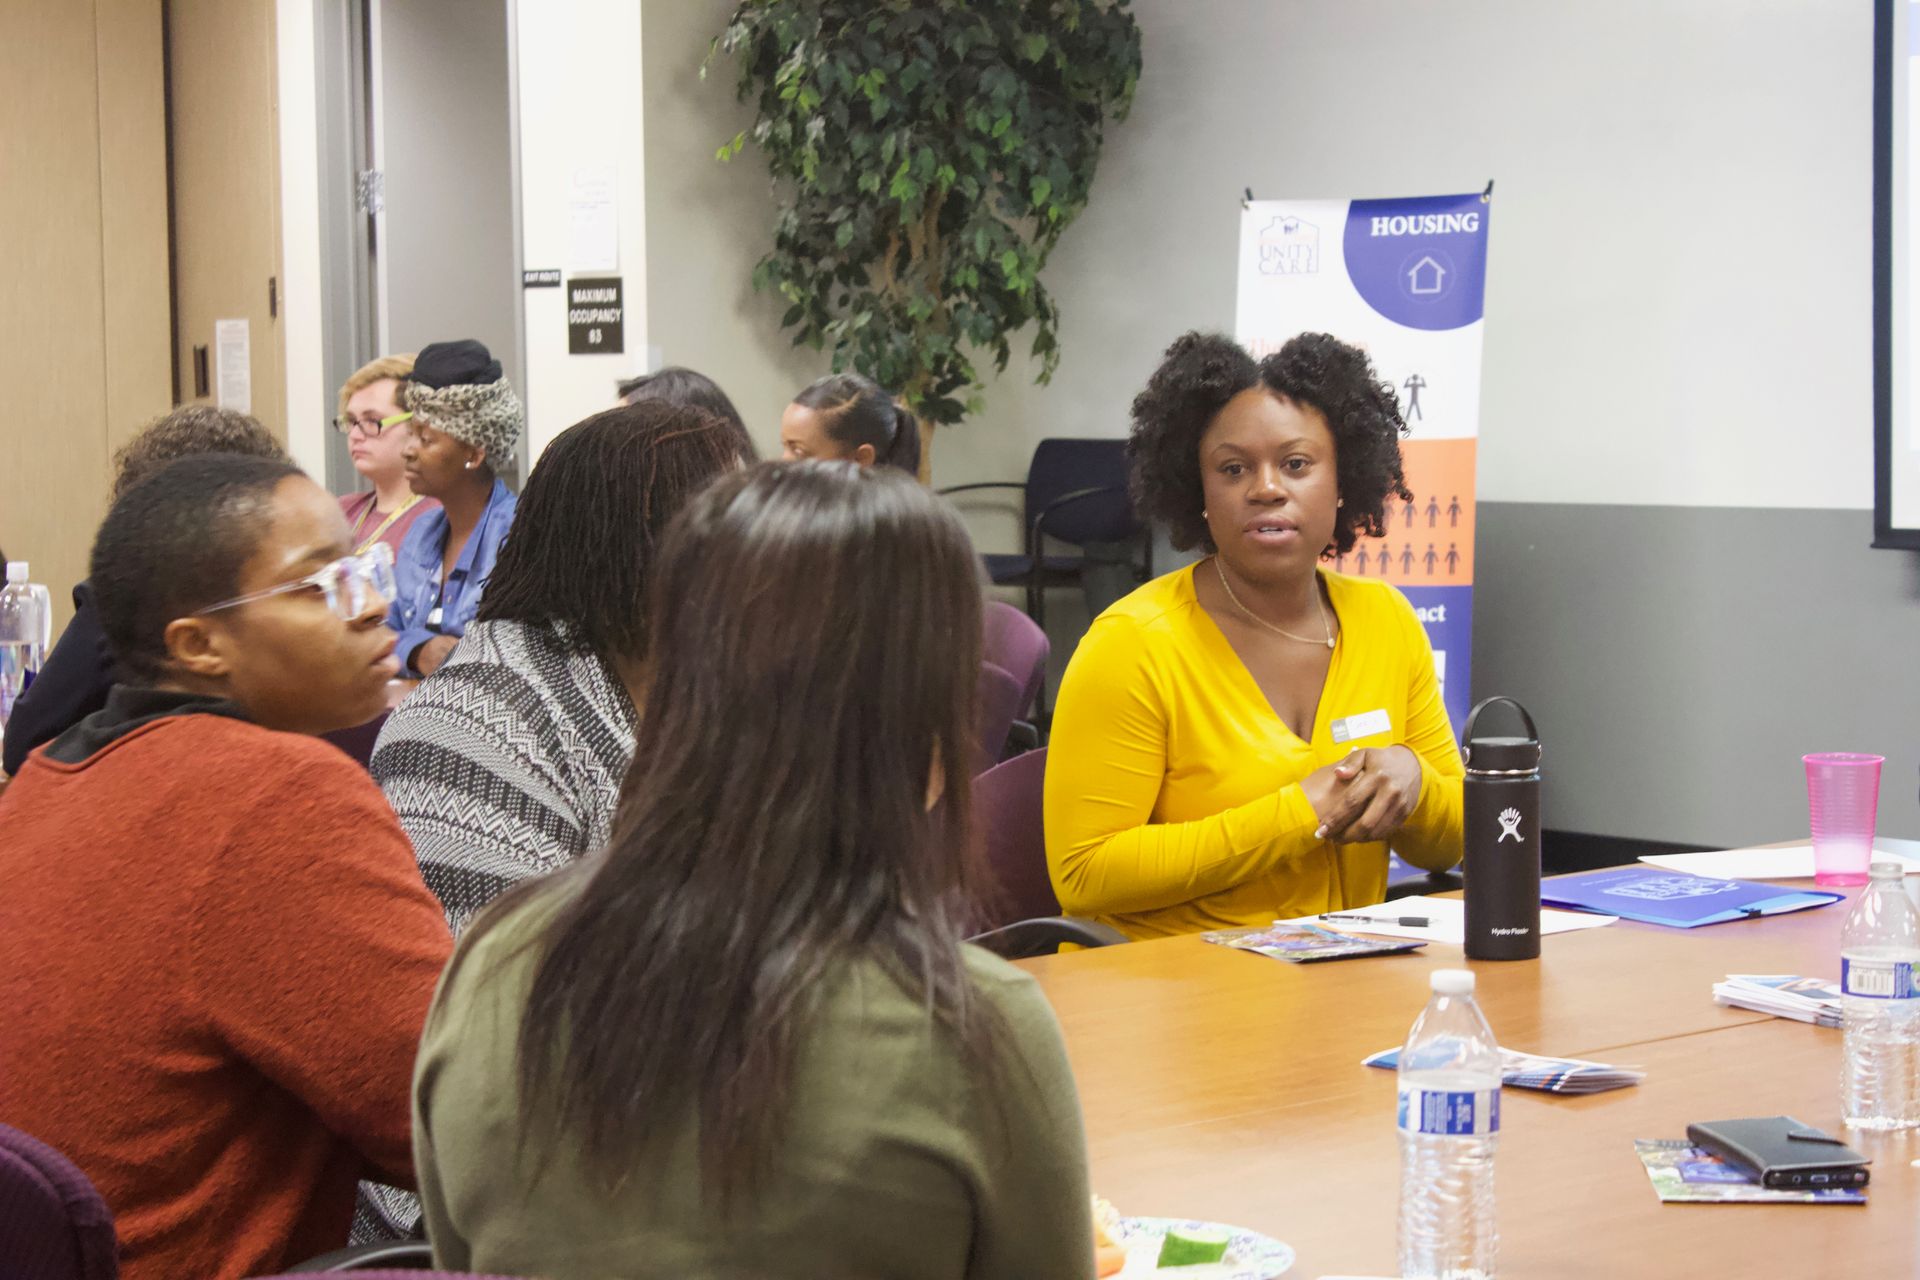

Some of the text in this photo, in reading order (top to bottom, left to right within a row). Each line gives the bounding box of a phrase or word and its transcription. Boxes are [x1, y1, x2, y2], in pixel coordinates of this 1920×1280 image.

[1370, 212, 1480, 237] HOUSING
[573, 287, 617, 303] MAXIMUM
[569, 308, 622, 324] OCCUPANCY
[1491, 927, 1511, 937] Hydro
